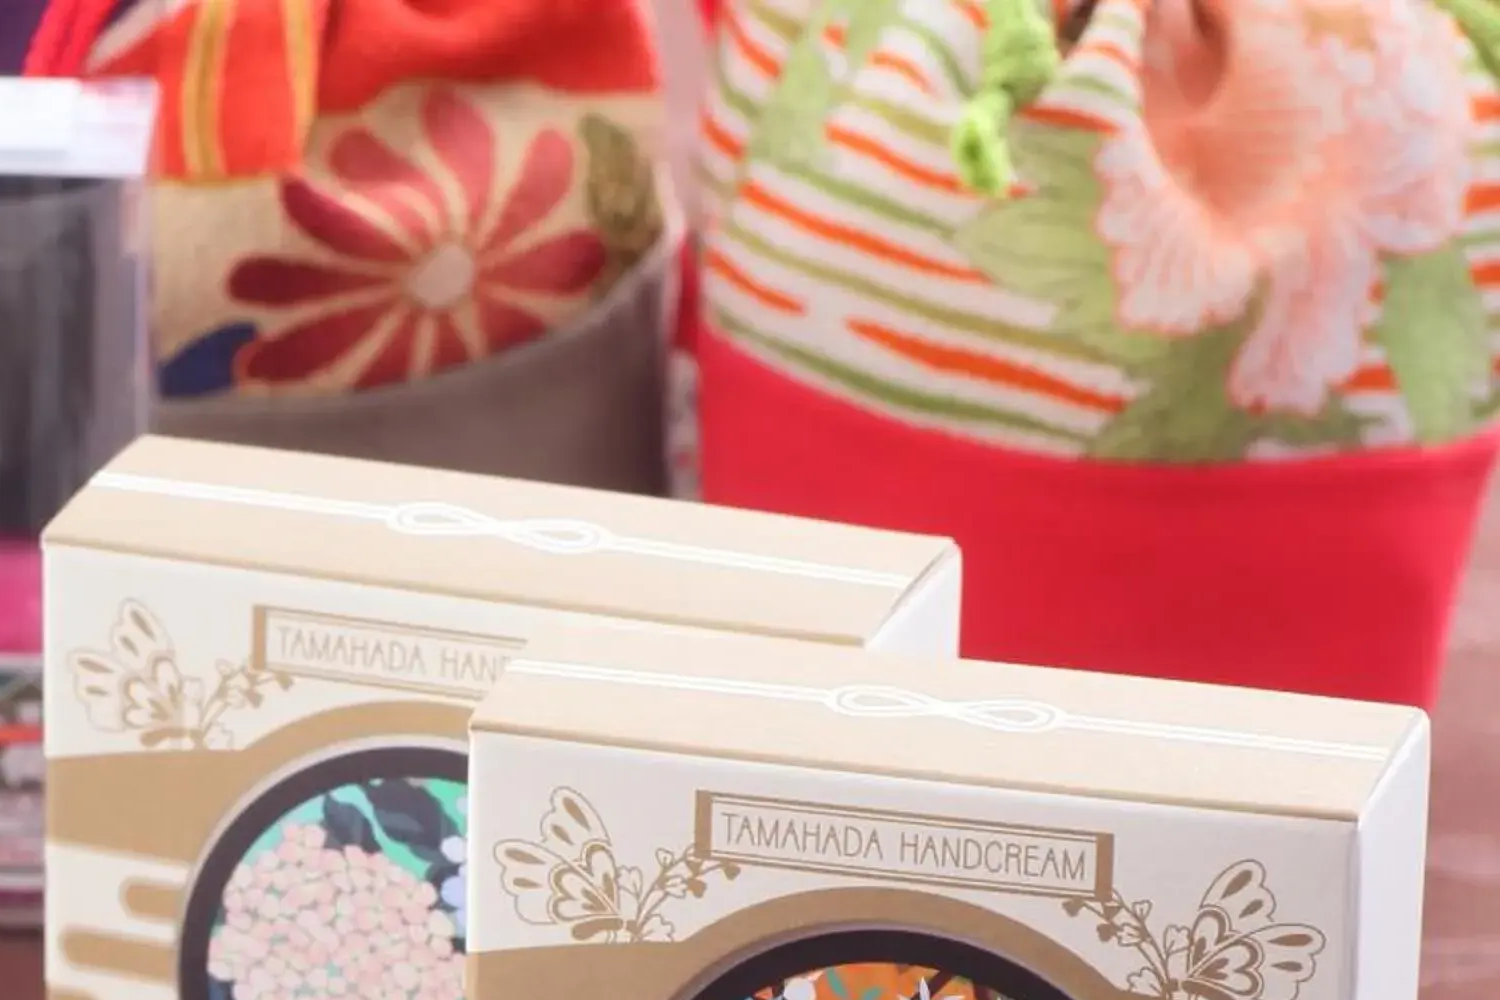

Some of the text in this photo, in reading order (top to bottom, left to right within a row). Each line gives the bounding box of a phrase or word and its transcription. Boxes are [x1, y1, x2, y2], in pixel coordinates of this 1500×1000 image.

[277, 626, 426, 675] TAMAHADA
[721, 811, 1085, 881] TAMAHADA HANDCREAM
